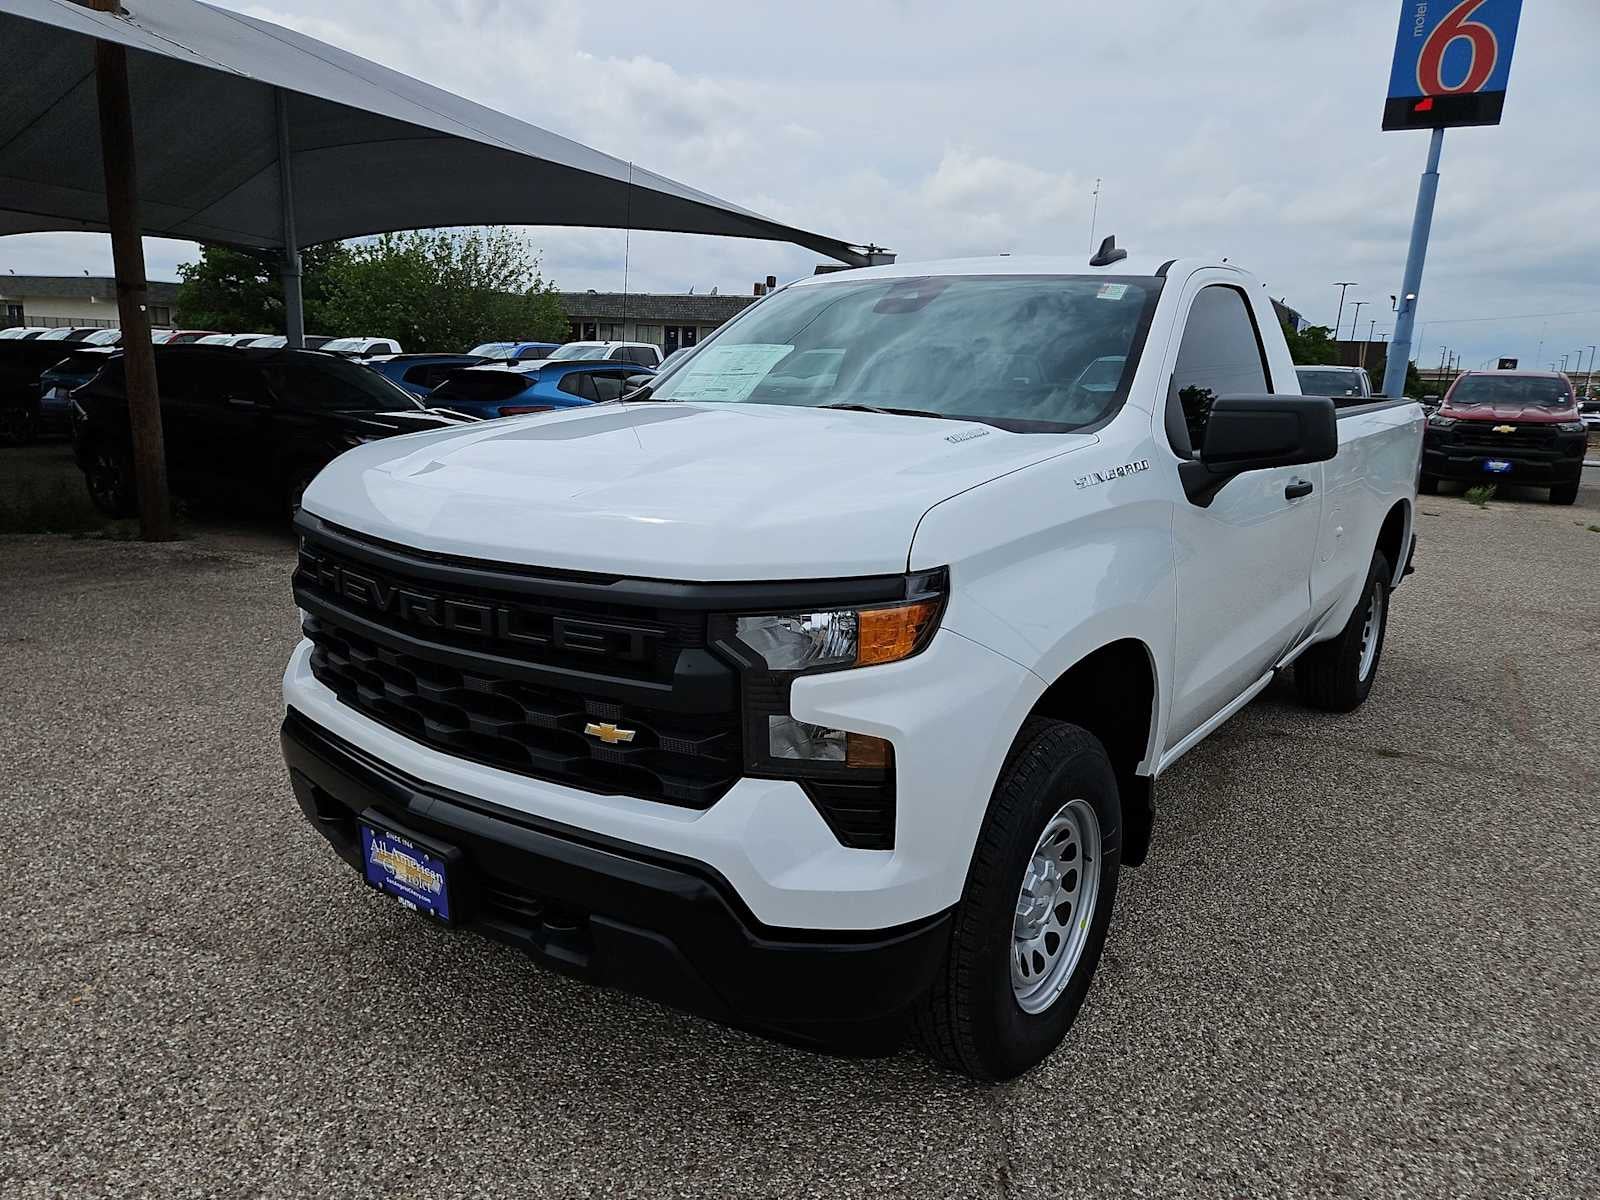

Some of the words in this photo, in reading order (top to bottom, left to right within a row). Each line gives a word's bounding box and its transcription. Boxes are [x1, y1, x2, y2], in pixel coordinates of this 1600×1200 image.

[1413, 2, 1427, 37] motel
[1416, 0, 1498, 96] 6
[1073, 459, 1150, 489] SILVERADO
[299, 549, 670, 663] CHEVROLET
[370, 838, 387, 853] All
